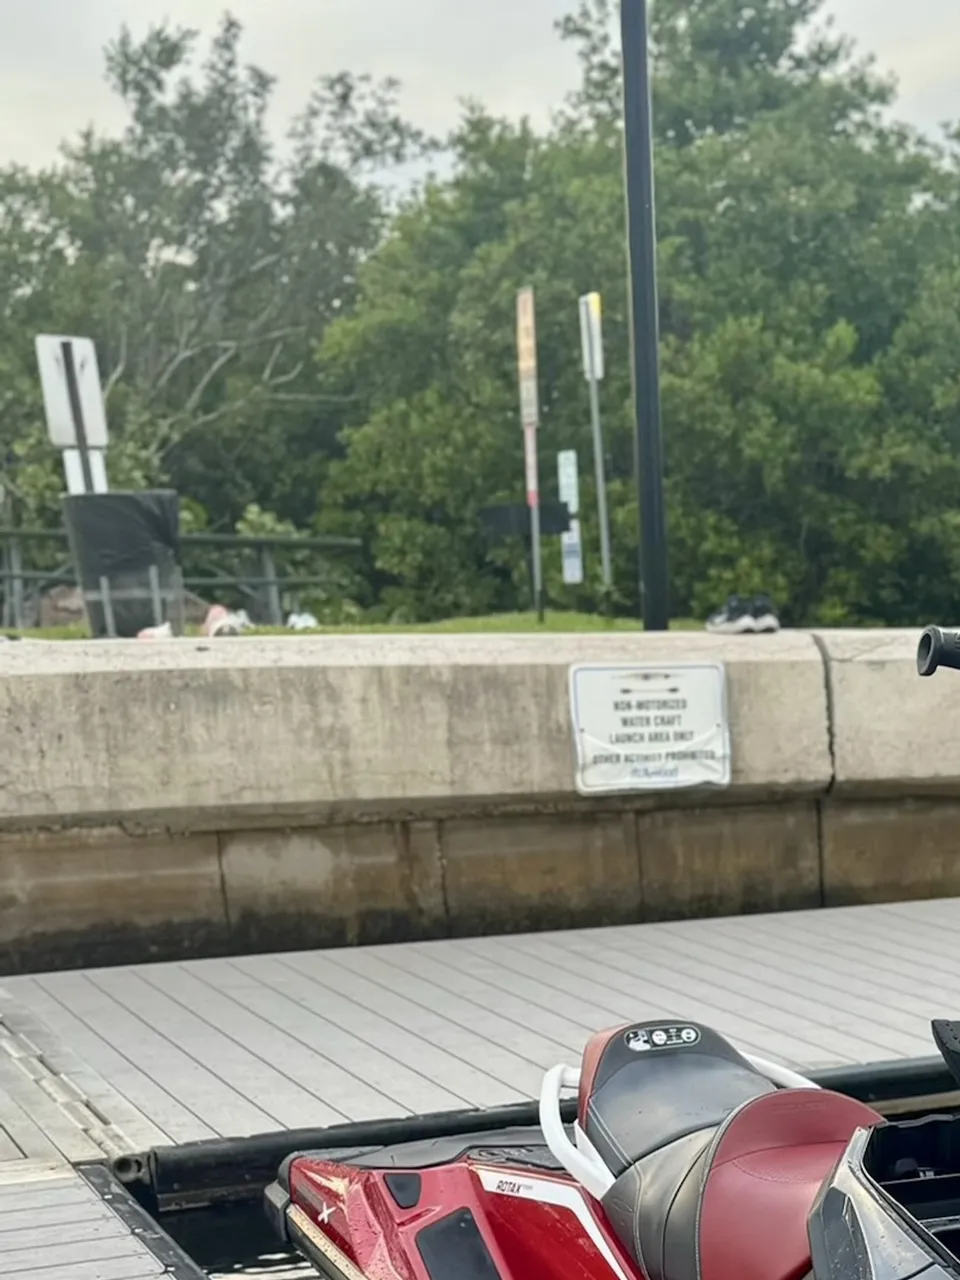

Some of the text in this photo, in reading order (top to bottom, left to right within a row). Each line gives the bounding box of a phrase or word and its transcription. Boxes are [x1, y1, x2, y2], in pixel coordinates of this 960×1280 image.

[613, 698, 687, 711] NON-MOTORIZED
[620, 714, 682, 727] WATER CRAFT
[609, 730, 694, 744] LAUNCH AREA ONLY
[592, 753, 621, 765] OTHER
[665, 749, 716, 761] PROHIBITED
[496, 1180, 522, 1194] ROTAX
